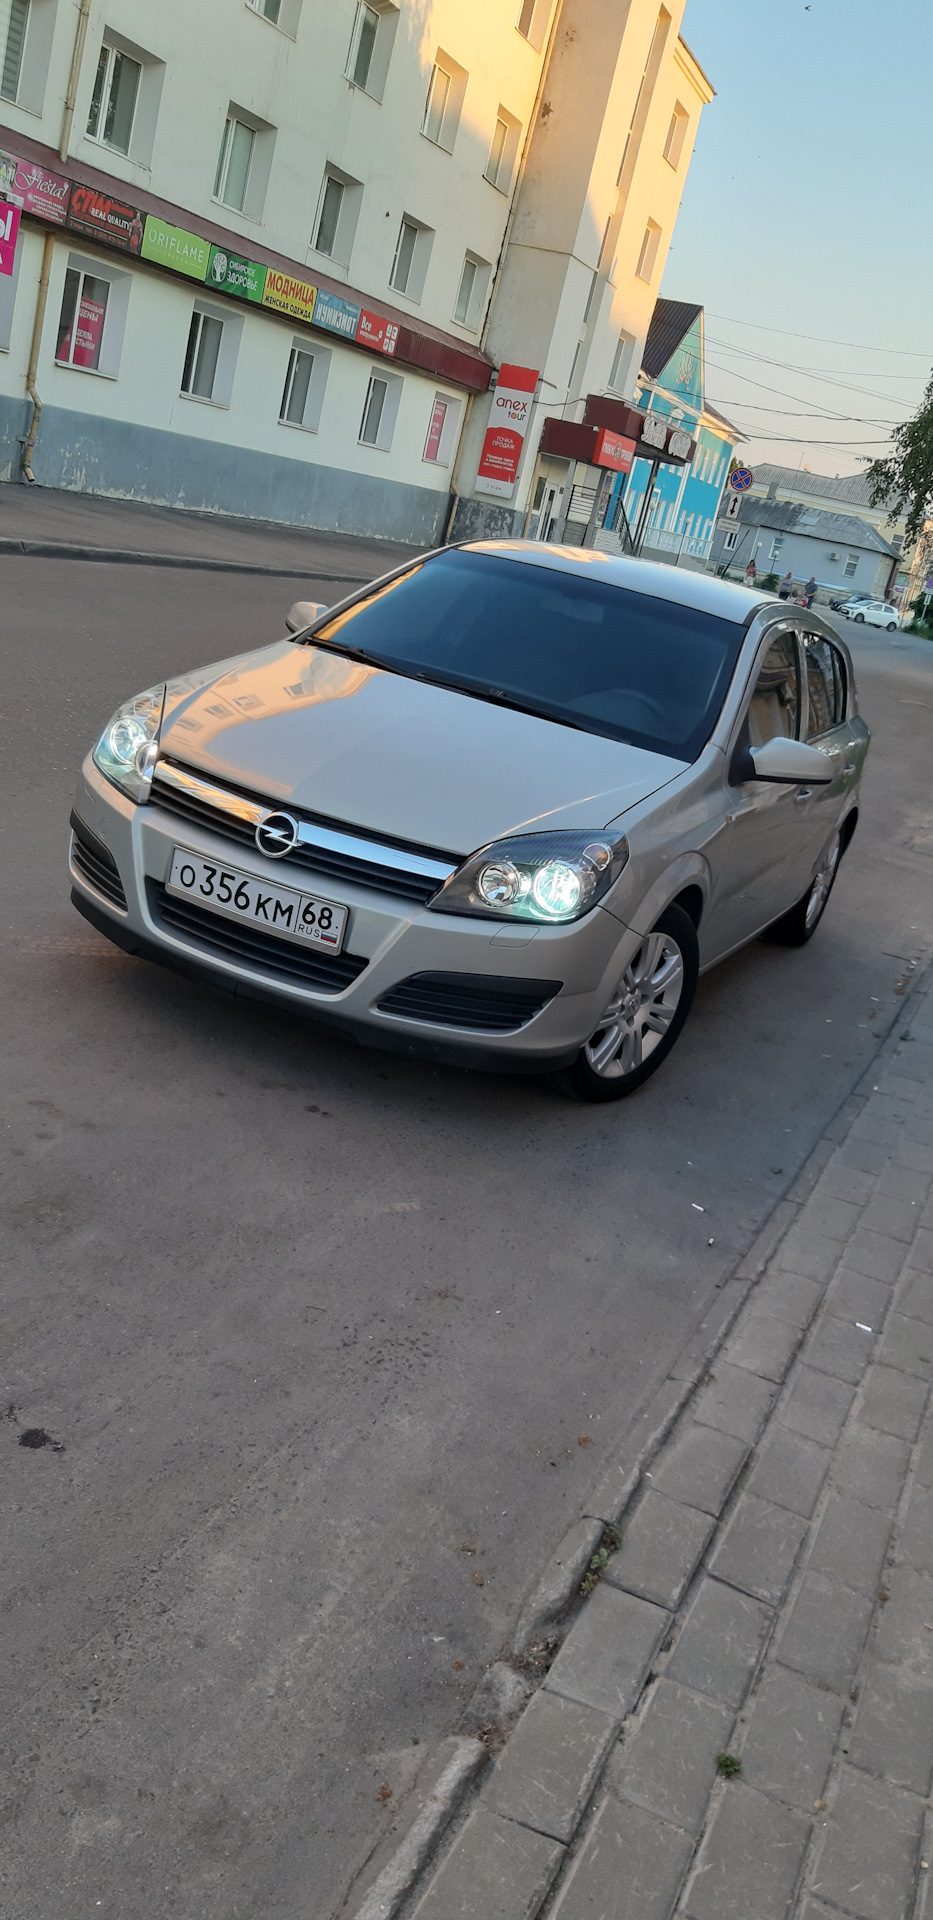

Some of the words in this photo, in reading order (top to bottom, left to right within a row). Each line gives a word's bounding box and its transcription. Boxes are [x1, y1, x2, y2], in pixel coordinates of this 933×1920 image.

[14, 171, 70, 200] Fiesta!
[91, 207, 106, 221] REAL
[107, 213, 131, 231] QUALITY
[147, 228, 205, 263] ORIFLAME
[229, 260, 256, 278] СИБИРСКОЕ
[226, 270, 259, 292] ЗДОРОВЬЕ
[266, 271, 315, 306] МОДНИЦА
[264, 294, 289, 311] ЖЕНСКАЯ
[289, 303, 312, 321] ОДЕЖДА
[315, 301, 358, 334] НУМИЗМАТ
[360, 314, 373, 330] Все
[496, 396, 528, 413] anex
[507, 411, 527, 421] tour
[491, 440, 515, 450] ПРОДАЖ
[496, 436, 514, 444] ТОЧКА
[301, 901, 333, 930] 68
[298, 923, 320, 938] RUS
